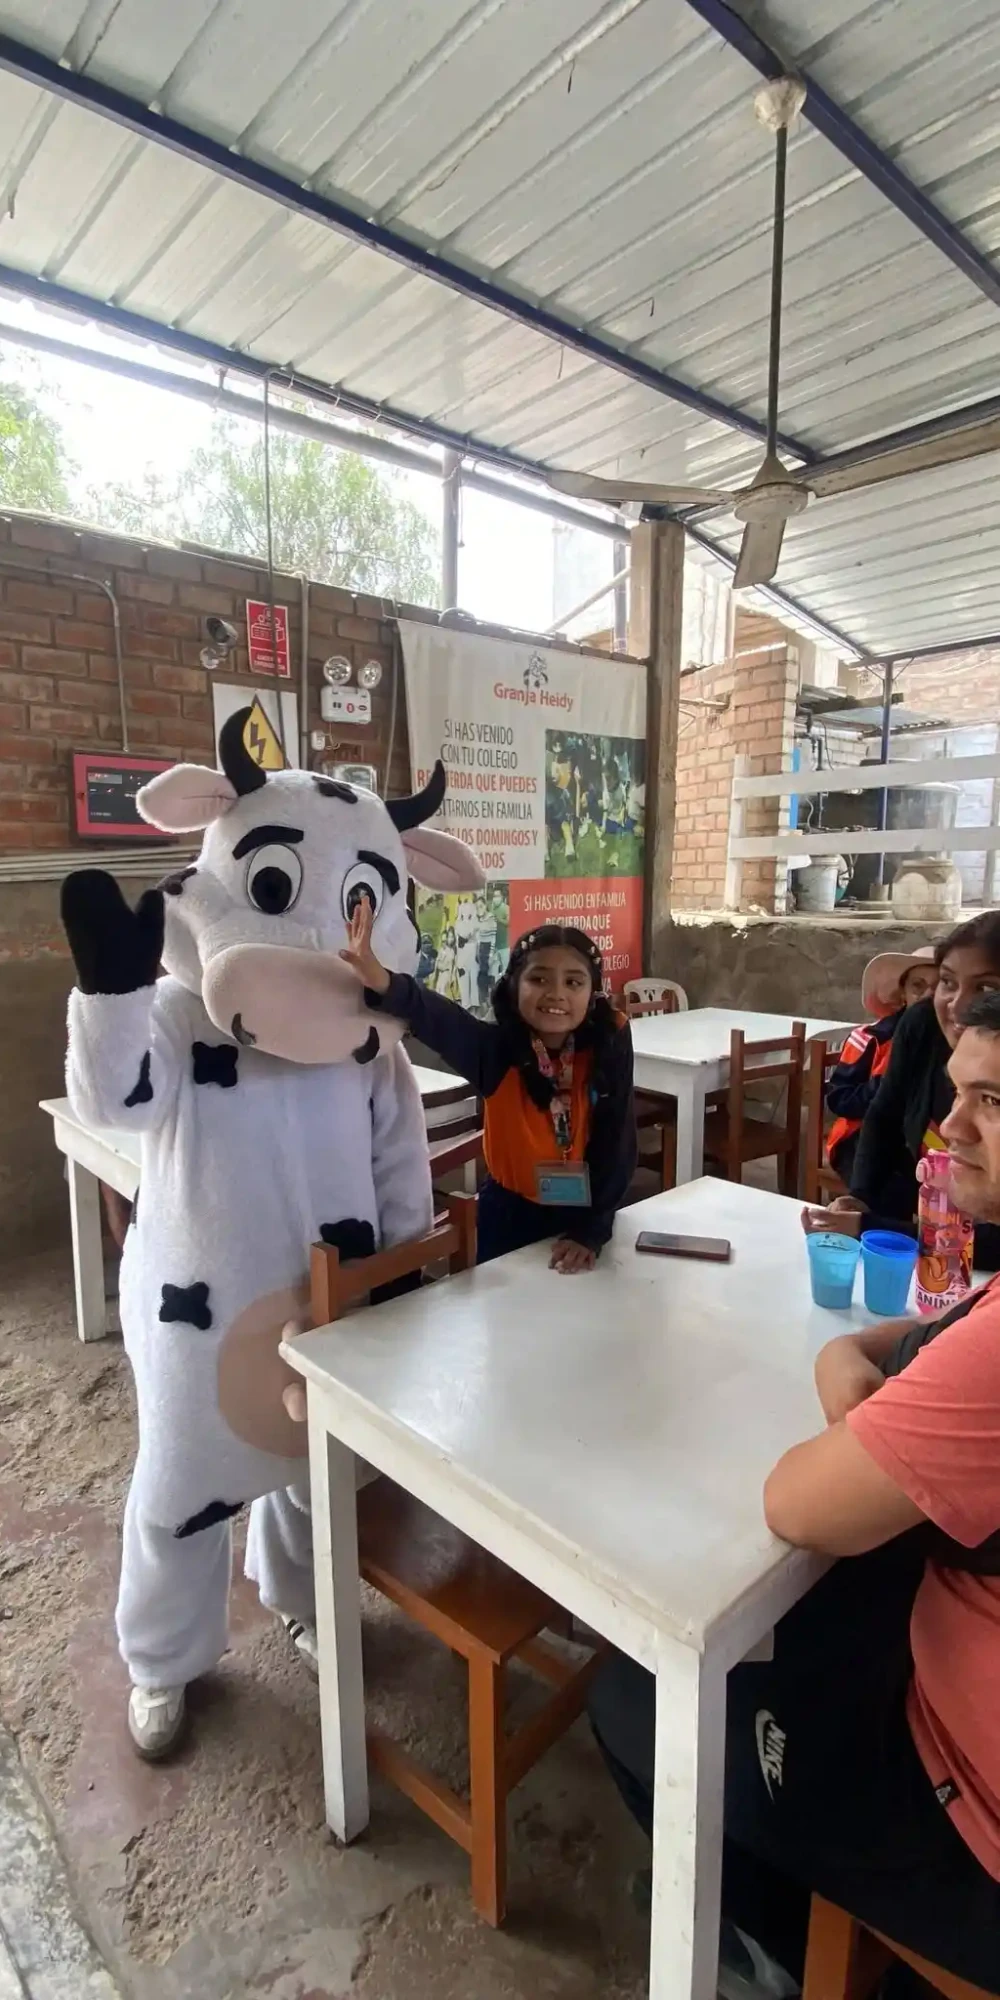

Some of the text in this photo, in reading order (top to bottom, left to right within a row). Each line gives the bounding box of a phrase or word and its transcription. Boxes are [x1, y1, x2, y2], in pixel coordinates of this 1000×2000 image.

[494, 682, 574, 713] Granja Heidy
[444, 718, 514, 746] SI HAS VENIDO
[441, 743, 518, 769] CON TU COLEGIO
[417, 768, 537, 794] REERDA QUE PUEDES
[435, 798, 532, 820] SITARNOS EN FAMILIA
[476, 828, 530, 847] DOMINGOS
[532, 830, 539, 847] Y
[523, 891, 626, 911] SI HAS VENIDO EN FAMILIA
[602, 953, 630, 971] OLEGIO
[765, 1720, 787, 1787] NIKE
